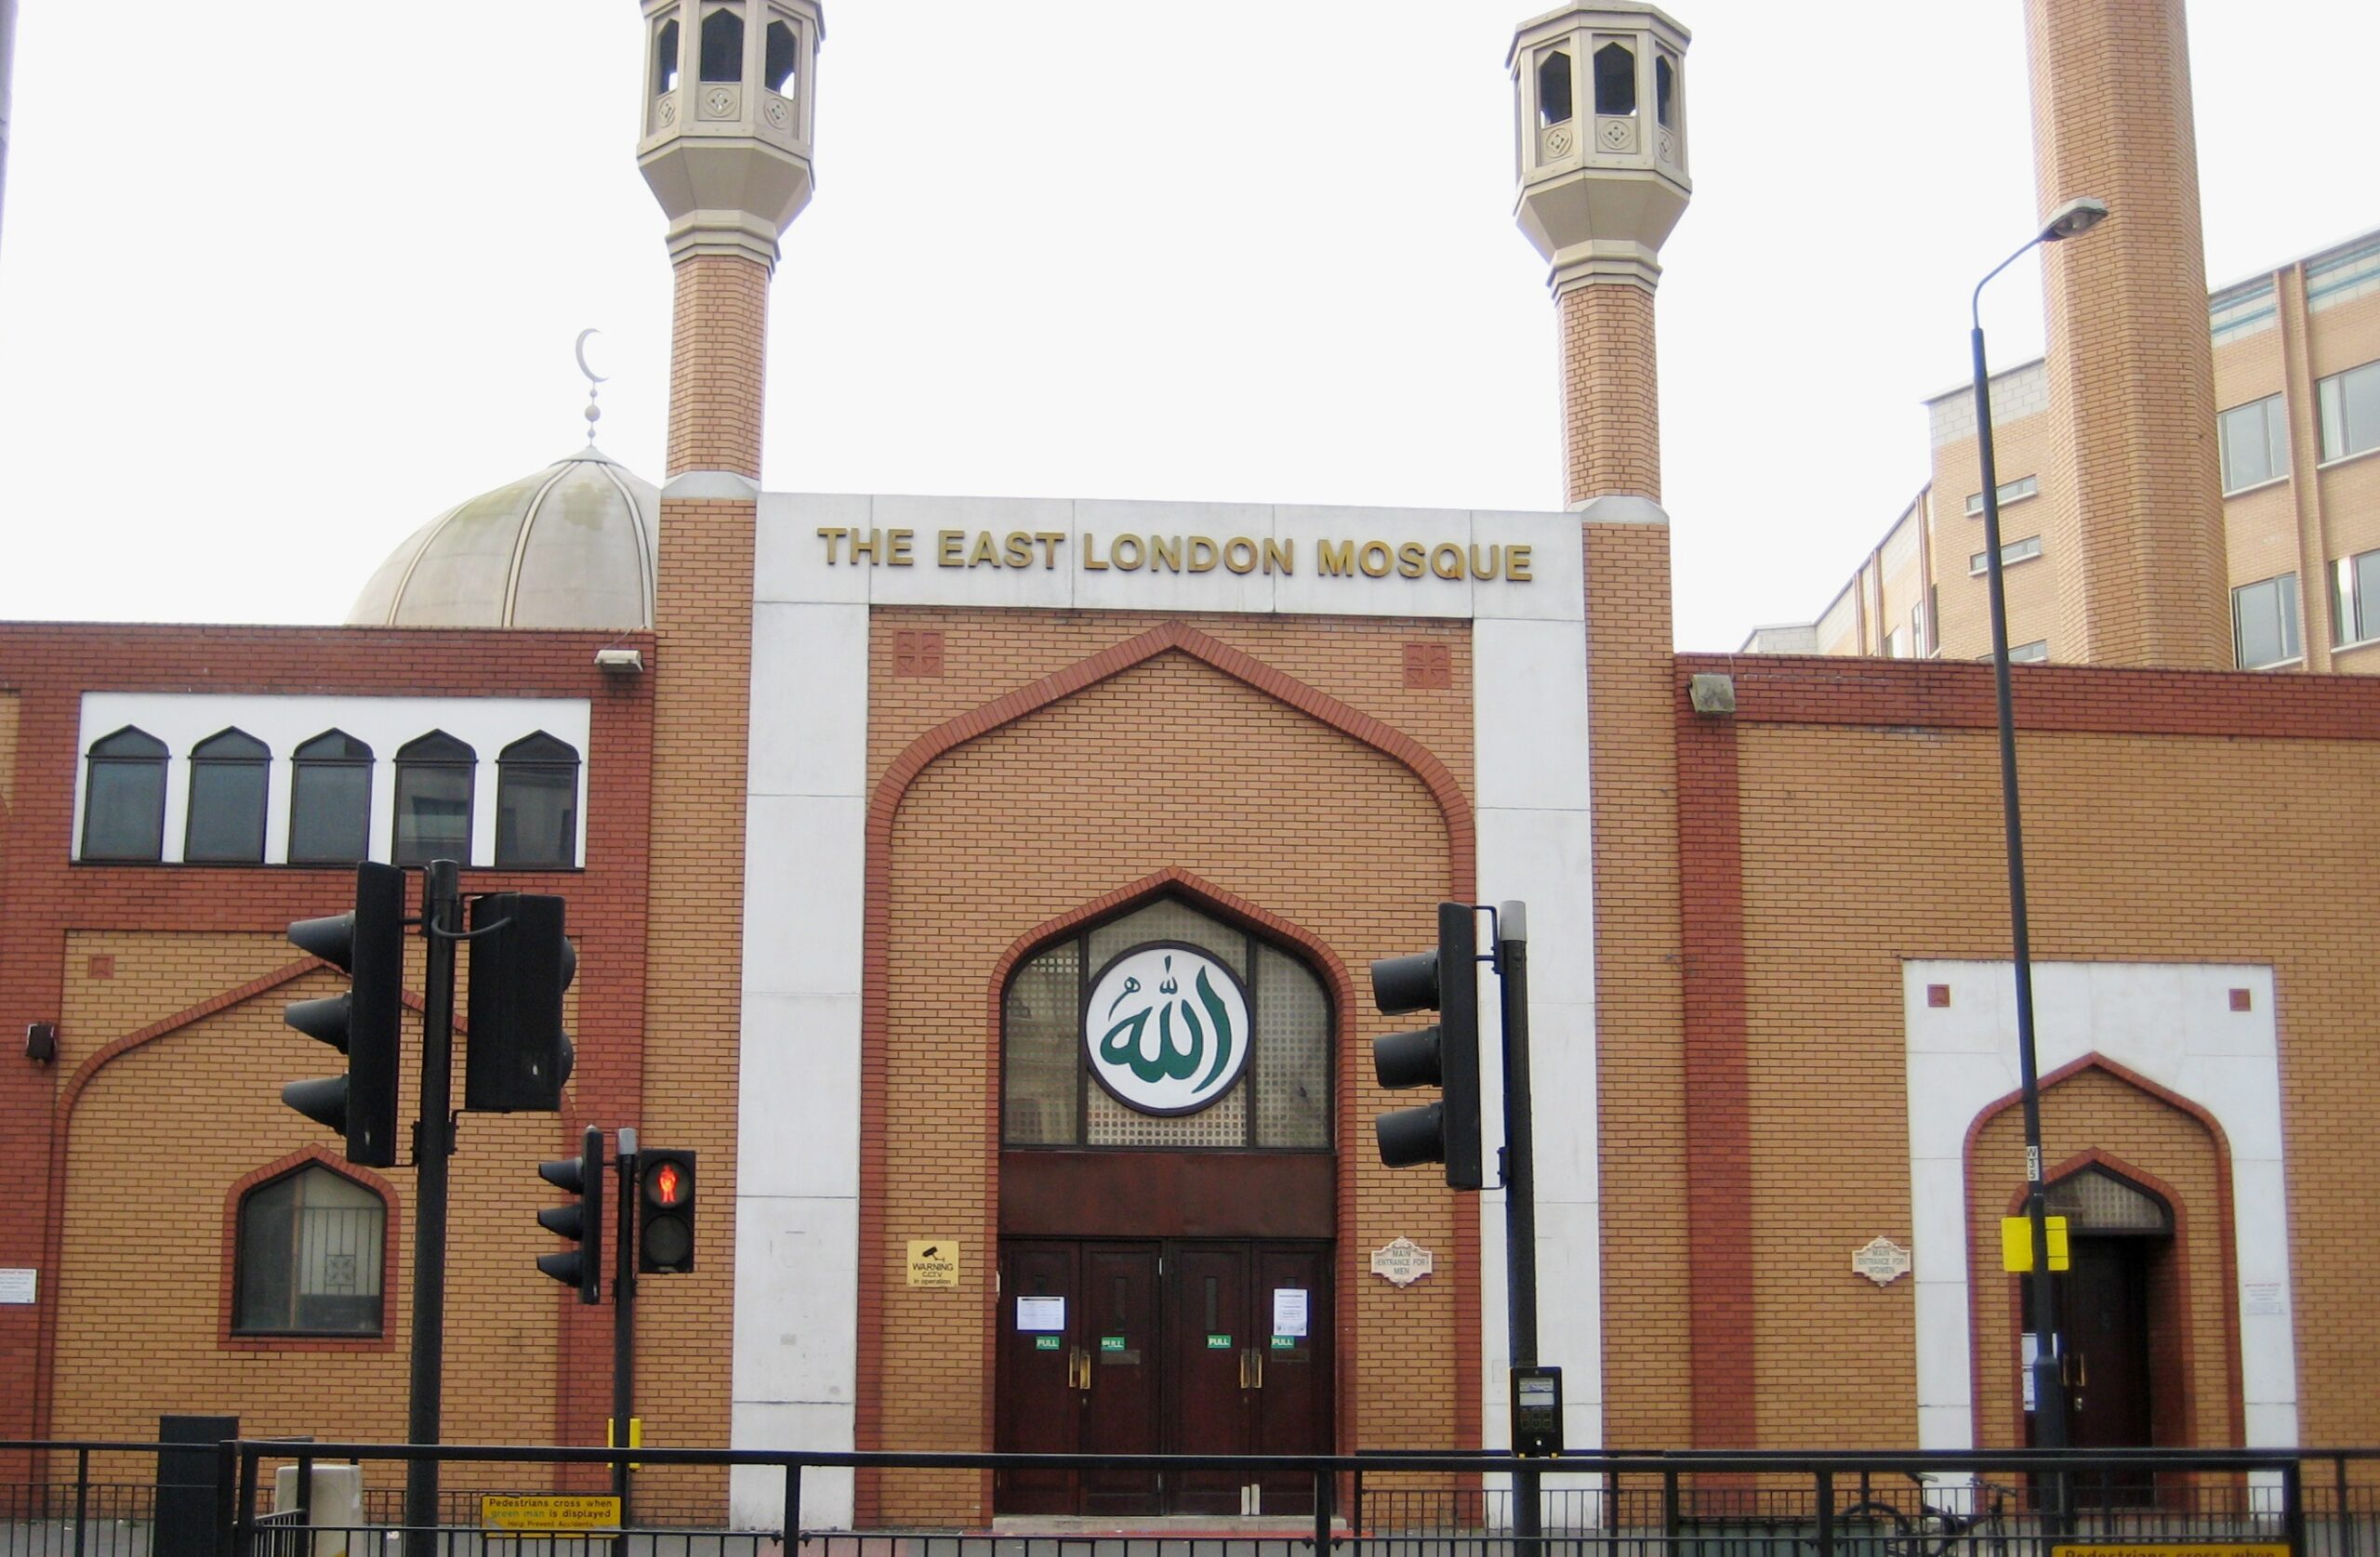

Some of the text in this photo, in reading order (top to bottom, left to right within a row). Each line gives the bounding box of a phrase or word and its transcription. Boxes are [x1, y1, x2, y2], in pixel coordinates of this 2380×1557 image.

[817, 527, 1533, 582] THE EAST LONDON MOSQUE
[912, 1262, 954, 1272] WARNING
[489, 1498, 549, 1507] Pedestrians
[586, 1498, 612, 1507] when
[491, 1510, 519, 1518] green
[562, 1509, 611, 1519] displayed
